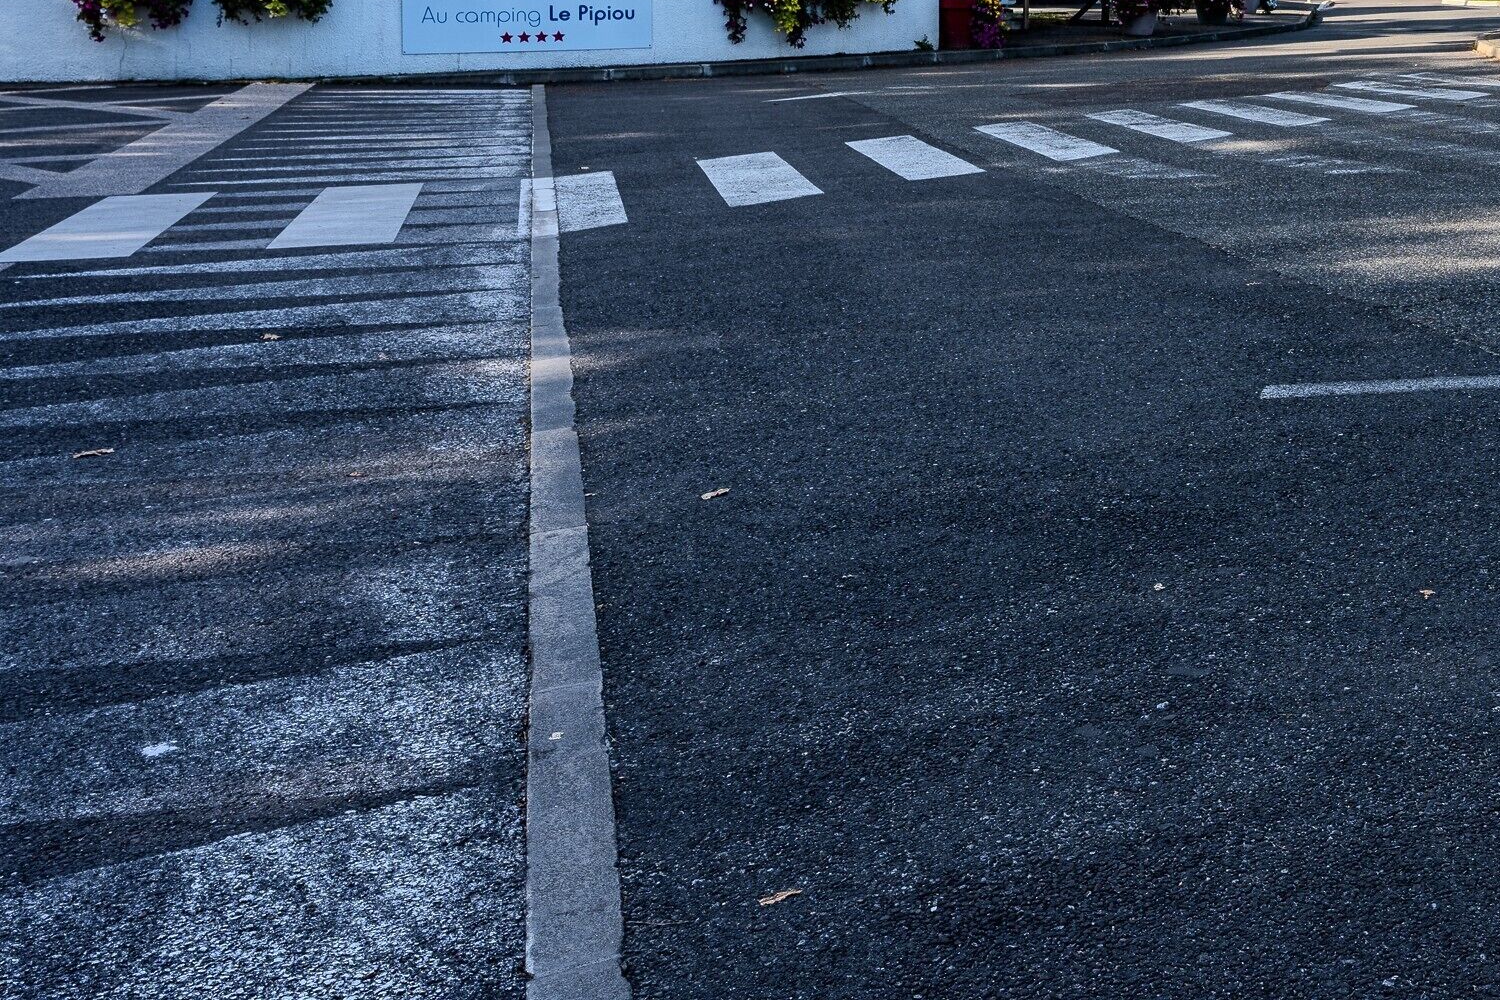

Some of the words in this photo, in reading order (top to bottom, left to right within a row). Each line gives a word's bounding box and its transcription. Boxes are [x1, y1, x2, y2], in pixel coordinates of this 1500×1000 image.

[421, 6, 448, 24] Au
[455, 7, 541, 28] camping
[549, 5, 571, 22] Le
[578, 4, 635, 26] Pipiou
